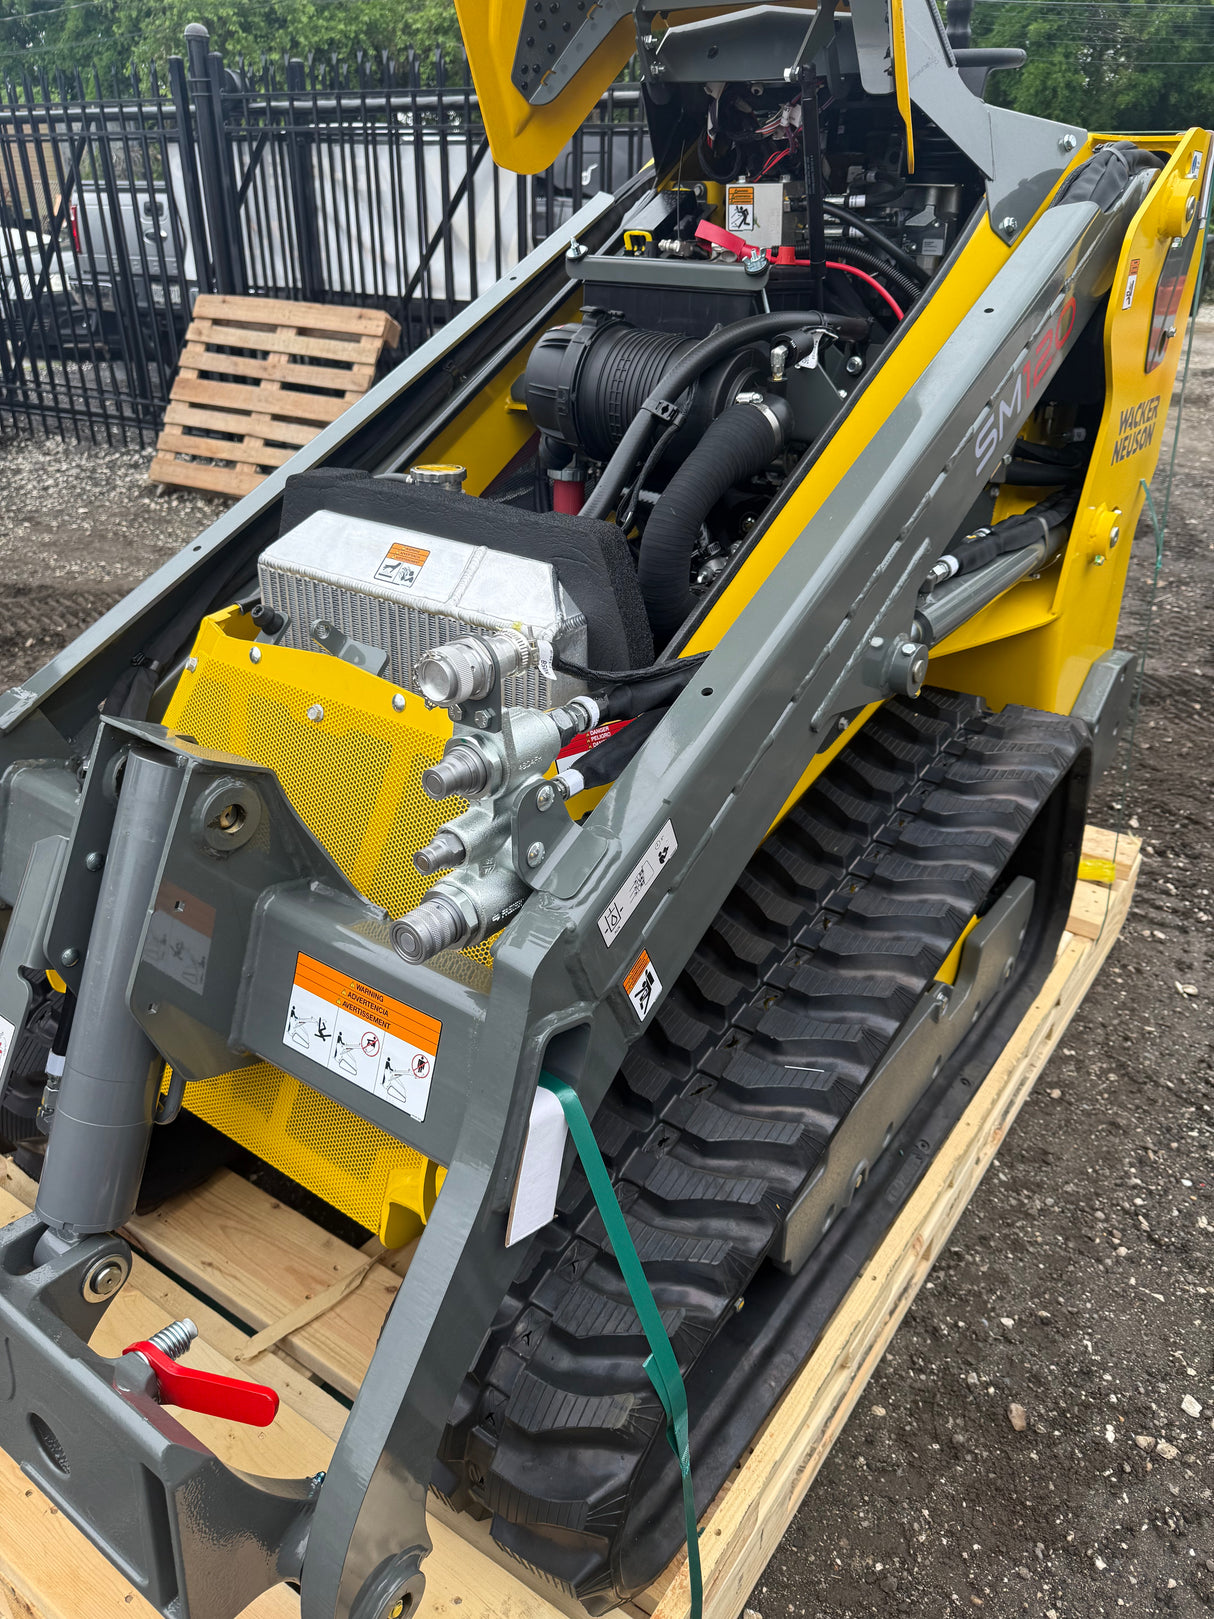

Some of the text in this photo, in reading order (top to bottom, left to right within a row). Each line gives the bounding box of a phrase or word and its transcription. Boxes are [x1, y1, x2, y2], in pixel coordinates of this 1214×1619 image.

[975, 297, 1077, 476] SM120
[1119, 395, 1160, 436] WACKER
[1110, 422, 1156, 467] NEUSON
[589, 726, 610, 736] DANGER
[347, 991, 389, 1017] ADVERTENCIA
[355, 983, 384, 1003] WARNING
[342, 1000, 391, 1030] AVERTISSEMENT
